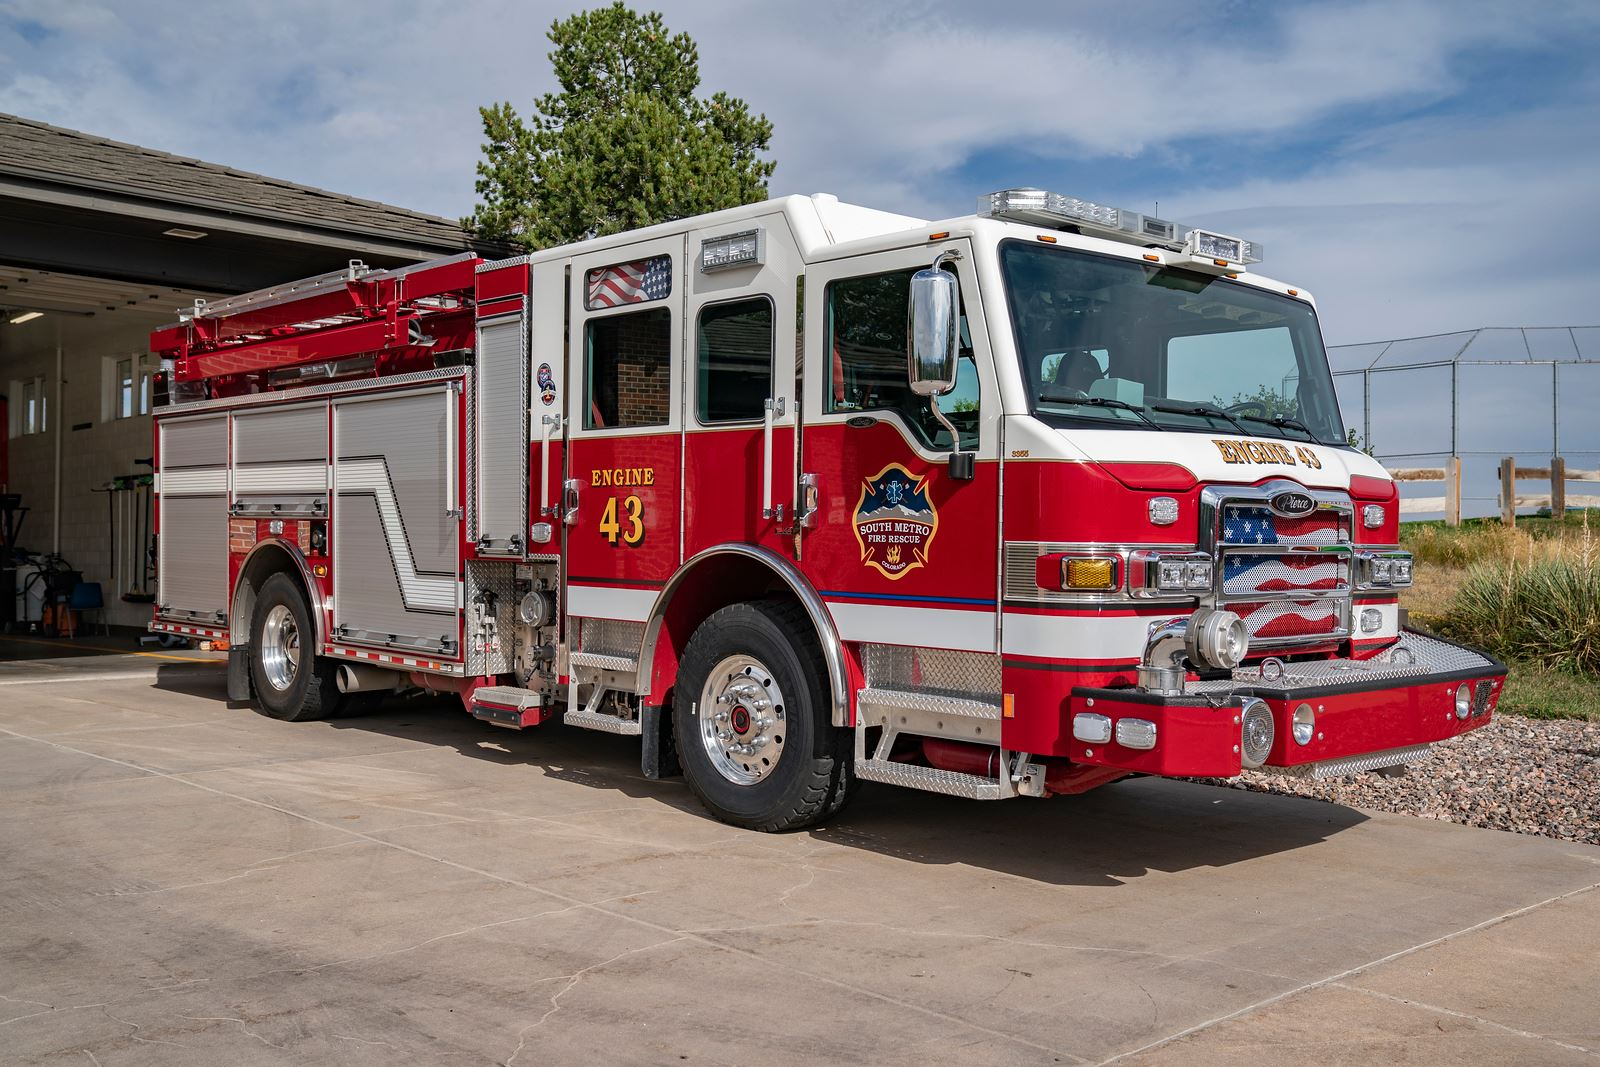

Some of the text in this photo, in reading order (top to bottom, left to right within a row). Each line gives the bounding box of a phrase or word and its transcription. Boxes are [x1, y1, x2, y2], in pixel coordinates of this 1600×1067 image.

[1211, 439, 1322, 470] ENGINE 43
[591, 467, 654, 487] ENGINE
[1280, 494, 1310, 511] Pierce
[599, 495, 646, 548] 43
[860, 522, 930, 536] SOUTH METRO
[868, 535, 920, 543] FIRE RESCUE
[881, 560, 906, 570] COLORADO
